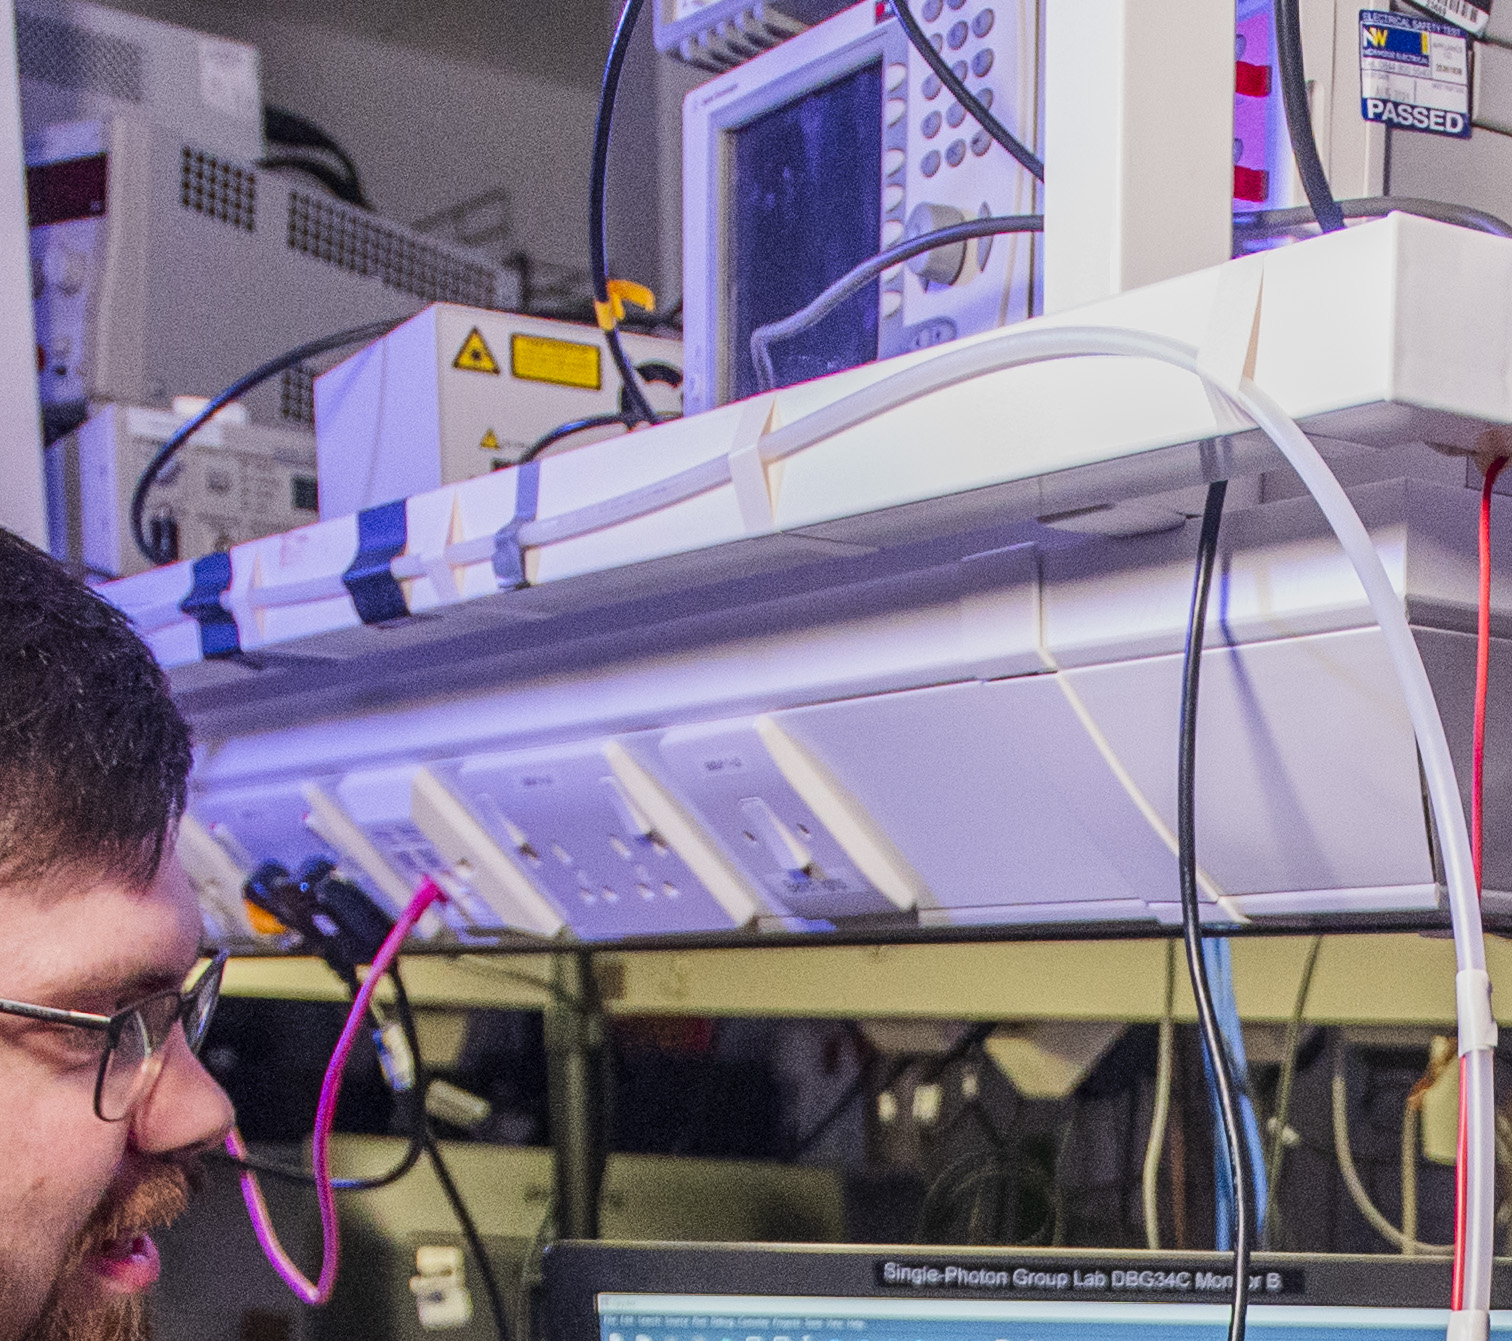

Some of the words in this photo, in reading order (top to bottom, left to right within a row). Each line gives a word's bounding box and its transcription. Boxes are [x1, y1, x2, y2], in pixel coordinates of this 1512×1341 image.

[1412, 20, 1441, 32] SAFETY
[1367, 99, 1464, 133] PASSED
[884, 1262, 1008, 1287] Single-Photon
[1012, 1268, 1068, 1290] Group
[1073, 1270, 1107, 1289] Lab
[1111, 1270, 1192, 1290] DBG34C
[1266, 1273, 1282, 1290] B
